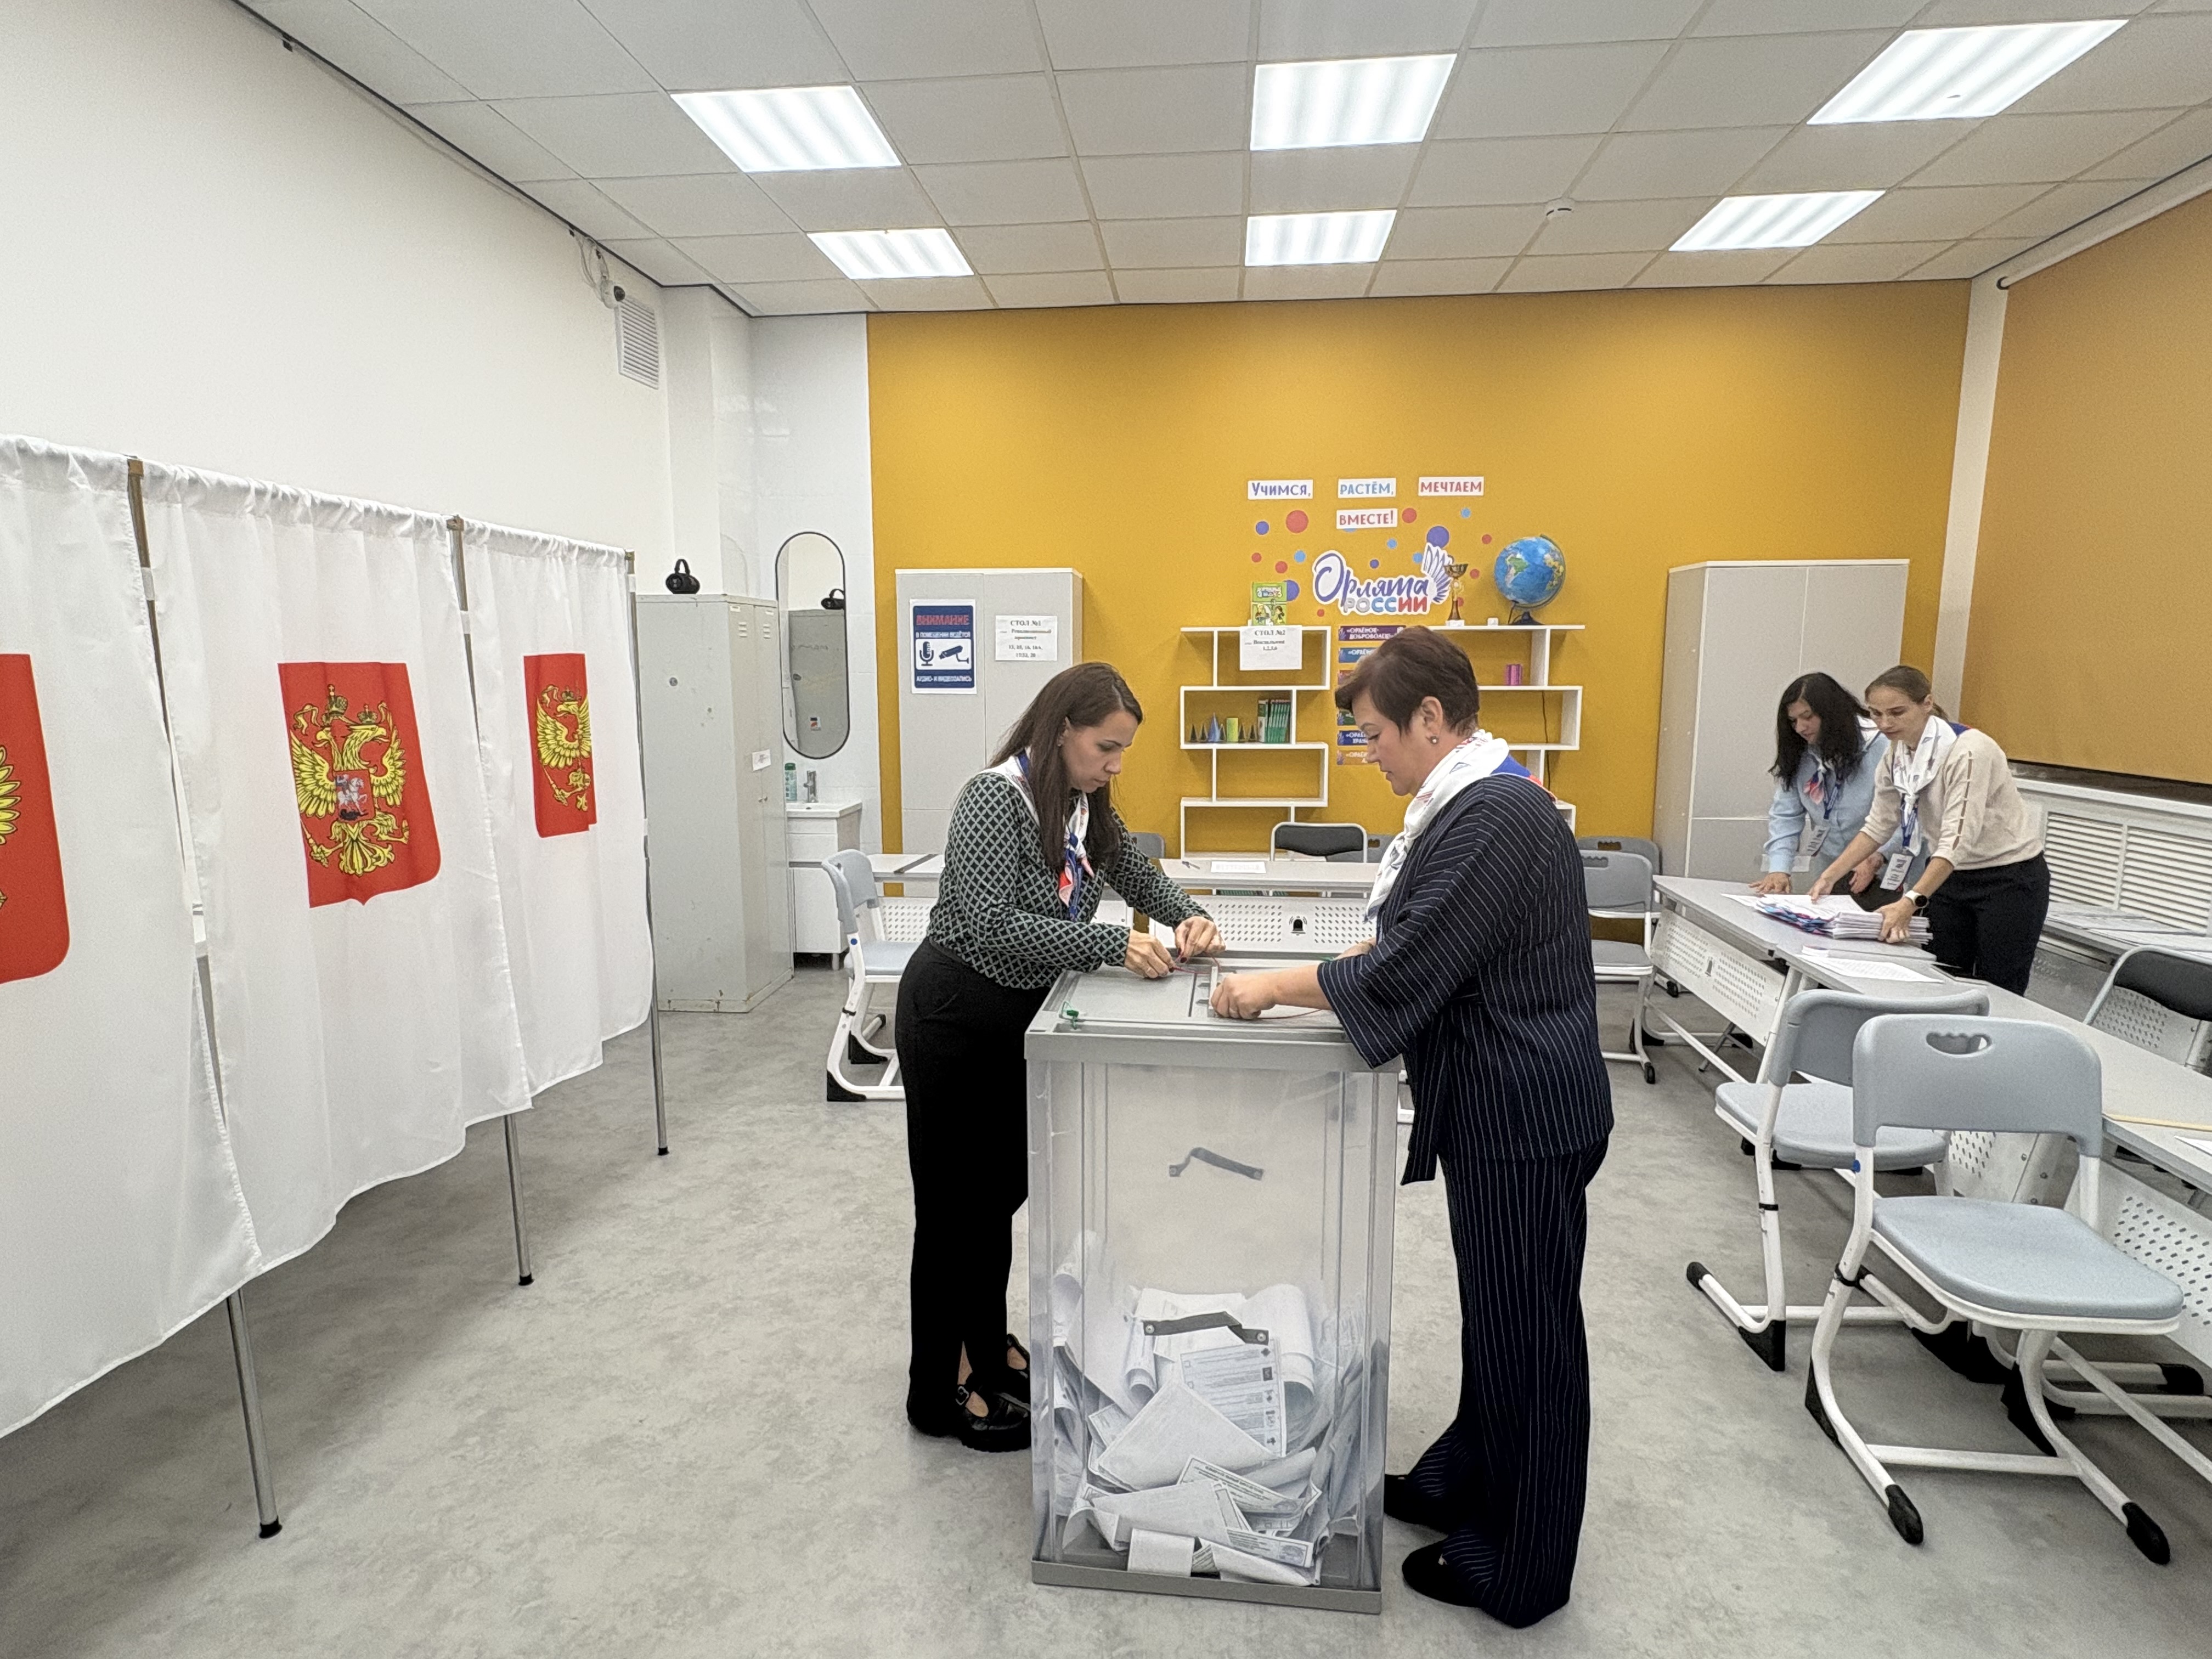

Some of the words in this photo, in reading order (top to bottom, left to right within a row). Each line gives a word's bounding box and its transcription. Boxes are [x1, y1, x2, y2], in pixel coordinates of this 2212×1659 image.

[1340, 481, 1393, 495] РАСТЁМ,
[1420, 482, 1481, 493] МЕЧТАЕМ
[1340, 510, 1393, 525] ВМЕСТЕ!
[1314, 553, 1429, 607] Орлята
[1344, 596, 1427, 613] РОССИИ
[916, 614, 969, 625] ВНИМАНИЕ
